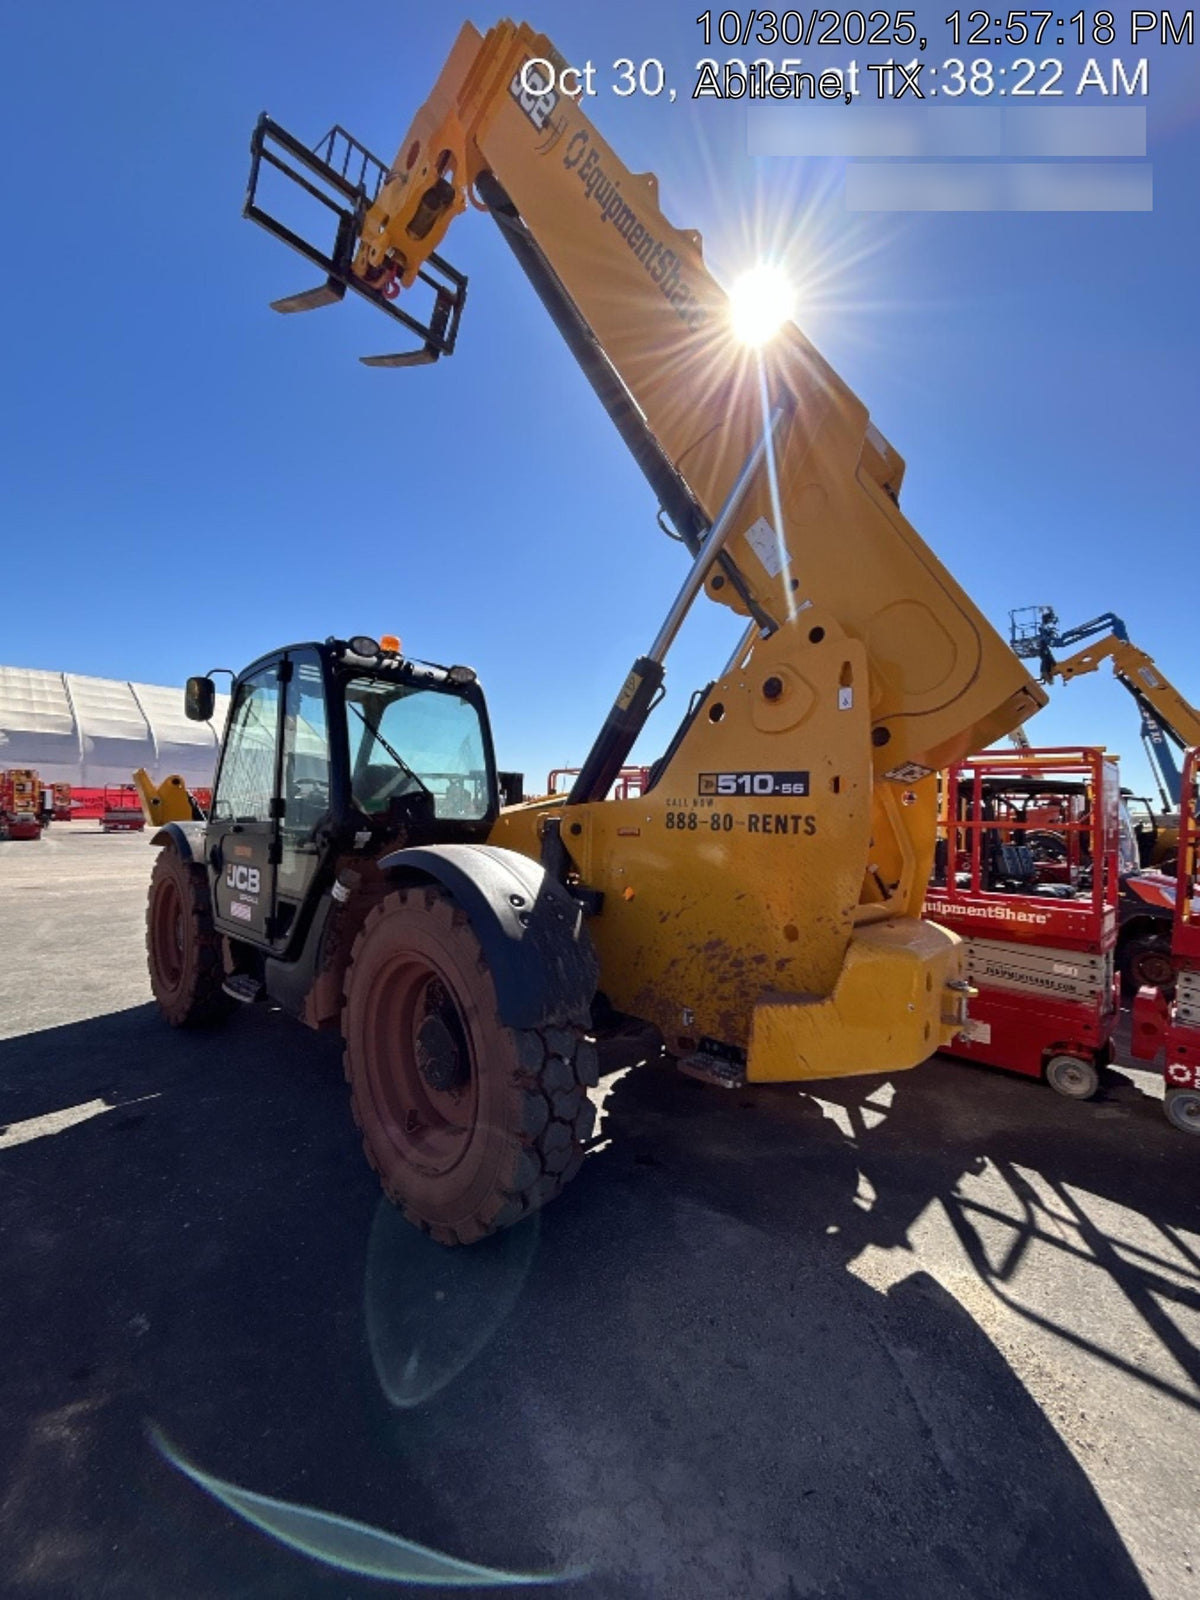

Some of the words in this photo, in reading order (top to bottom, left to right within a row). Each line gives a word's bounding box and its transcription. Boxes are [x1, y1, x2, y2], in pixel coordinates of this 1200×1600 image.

[665, 811, 817, 836] 888-80-RENTS
[226, 863, 260, 893] JCB
[922, 900, 1048, 924] uipmentShare
